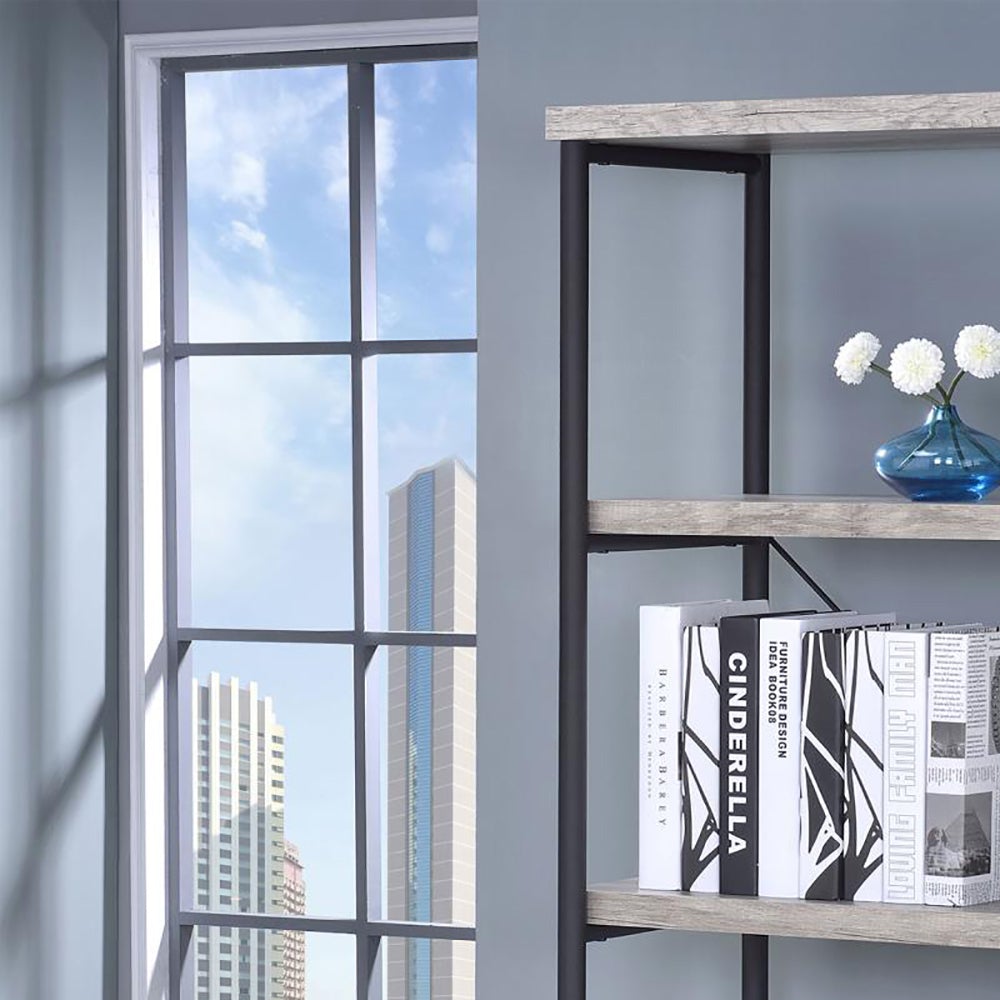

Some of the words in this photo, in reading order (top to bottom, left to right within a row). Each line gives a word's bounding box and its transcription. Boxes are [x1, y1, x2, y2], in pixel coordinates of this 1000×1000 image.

[769, 641, 778, 669] IDEA
[779, 641, 788, 710] FURNITURE
[888, 640, 916, 698] MAN
[768, 675, 777, 724] BOOK08
[727, 652, 748, 855] CINDERELLA
[778, 713, 788, 759] DESIGN
[888, 709, 916, 803] FAMILY
[888, 814, 916, 900] LOVING
